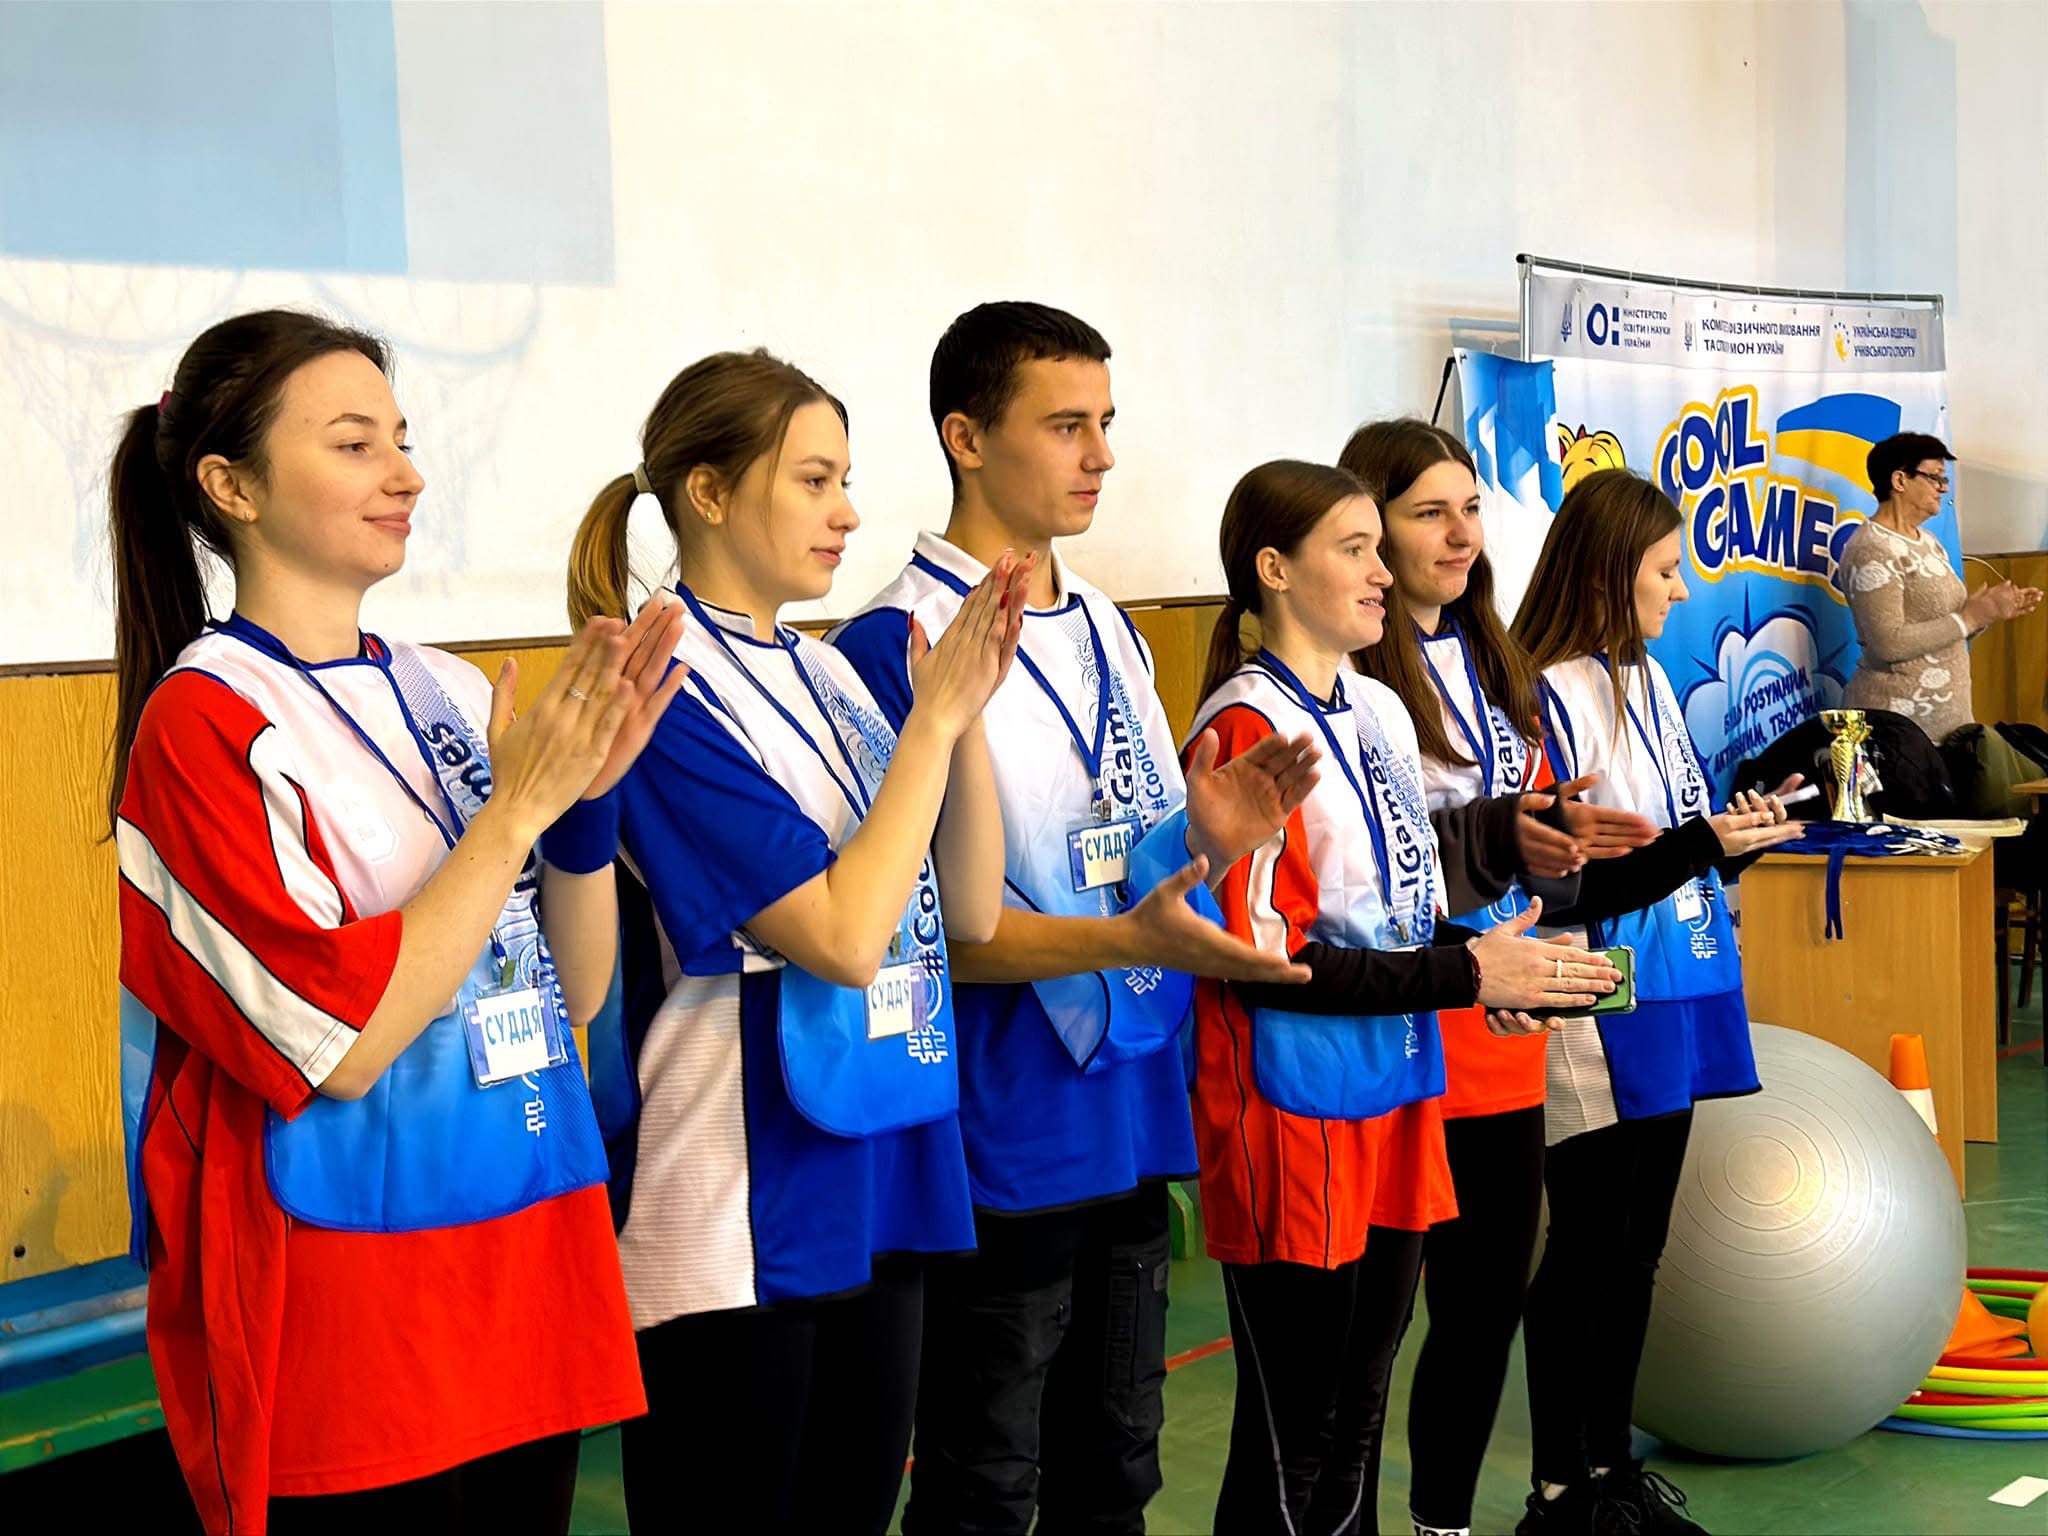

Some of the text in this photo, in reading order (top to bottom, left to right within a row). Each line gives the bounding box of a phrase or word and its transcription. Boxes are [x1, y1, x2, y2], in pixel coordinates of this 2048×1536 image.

[1660, 397, 1765, 508] COOL
[1085, 829, 1132, 862] СУДДЯ
[870, 977, 911, 1012] СУДДЯ
[485, 1004, 542, 1046] СУДДЯ
